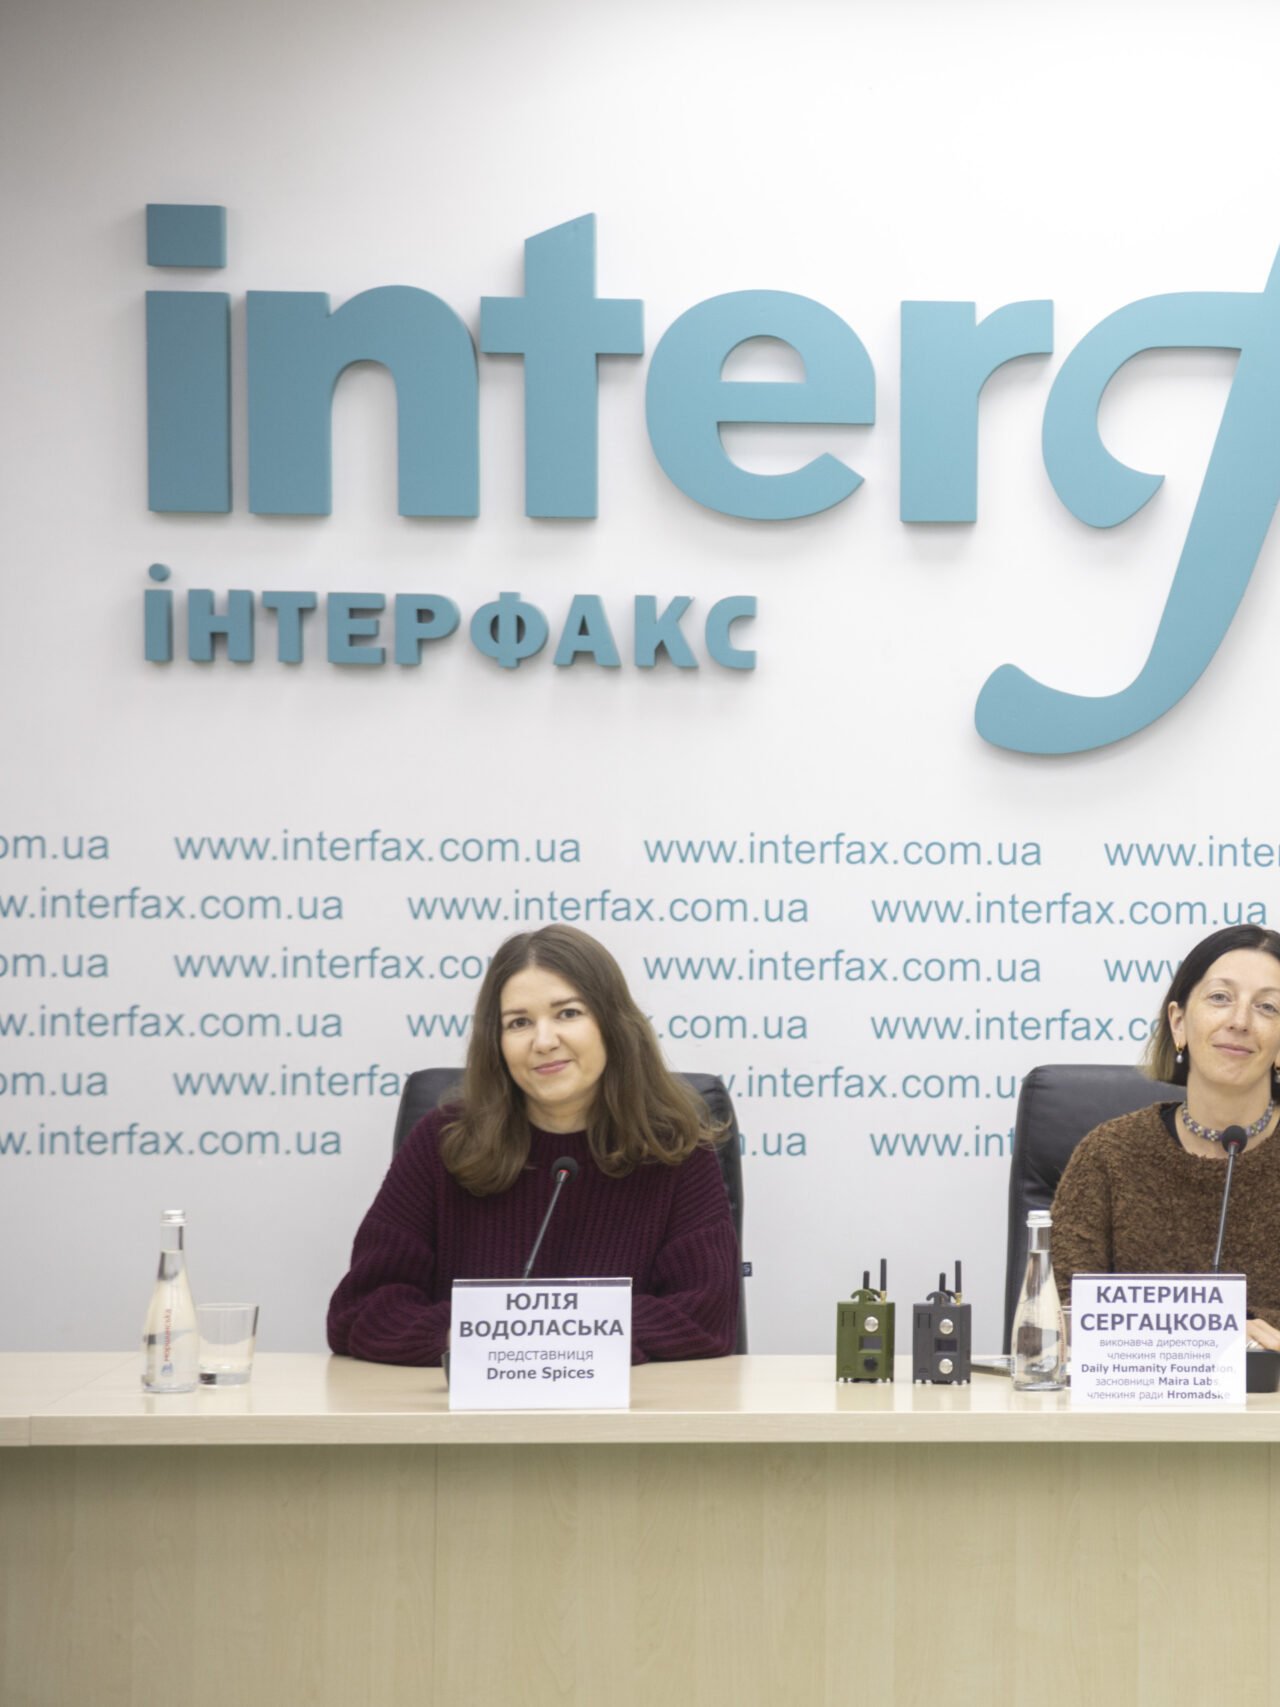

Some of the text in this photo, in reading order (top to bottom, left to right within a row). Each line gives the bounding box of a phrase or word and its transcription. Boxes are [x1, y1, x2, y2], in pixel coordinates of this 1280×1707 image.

[174, 828, 581, 863] www.interfax.com.ua
[643, 832, 1042, 868] www.interfax.com.ua
[407, 887, 809, 924] www.interfax.com.ua
[870, 891, 1268, 927] www.interfax.com.ua
[642, 948, 1042, 984] www.interfax.com.ua
[506, 1292, 578, 1311] ЮЛІЯ
[1096, 1286, 1223, 1304] КАТЕРИНА
[459, 1319, 624, 1341] ВОДОЛАСЬКА
[1080, 1313, 1239, 1334] СЕРГАЦКОВА
[1099, 1338, 1154, 1348] виконавча
[488, 1349, 594, 1363] представниця
[486, 1365, 595, 1382] Drone Spices
[1081, 1363, 1109, 1376] Daily
[1112, 1363, 1168, 1376] Humanity
[1157, 1376, 1190, 1387] Maira
